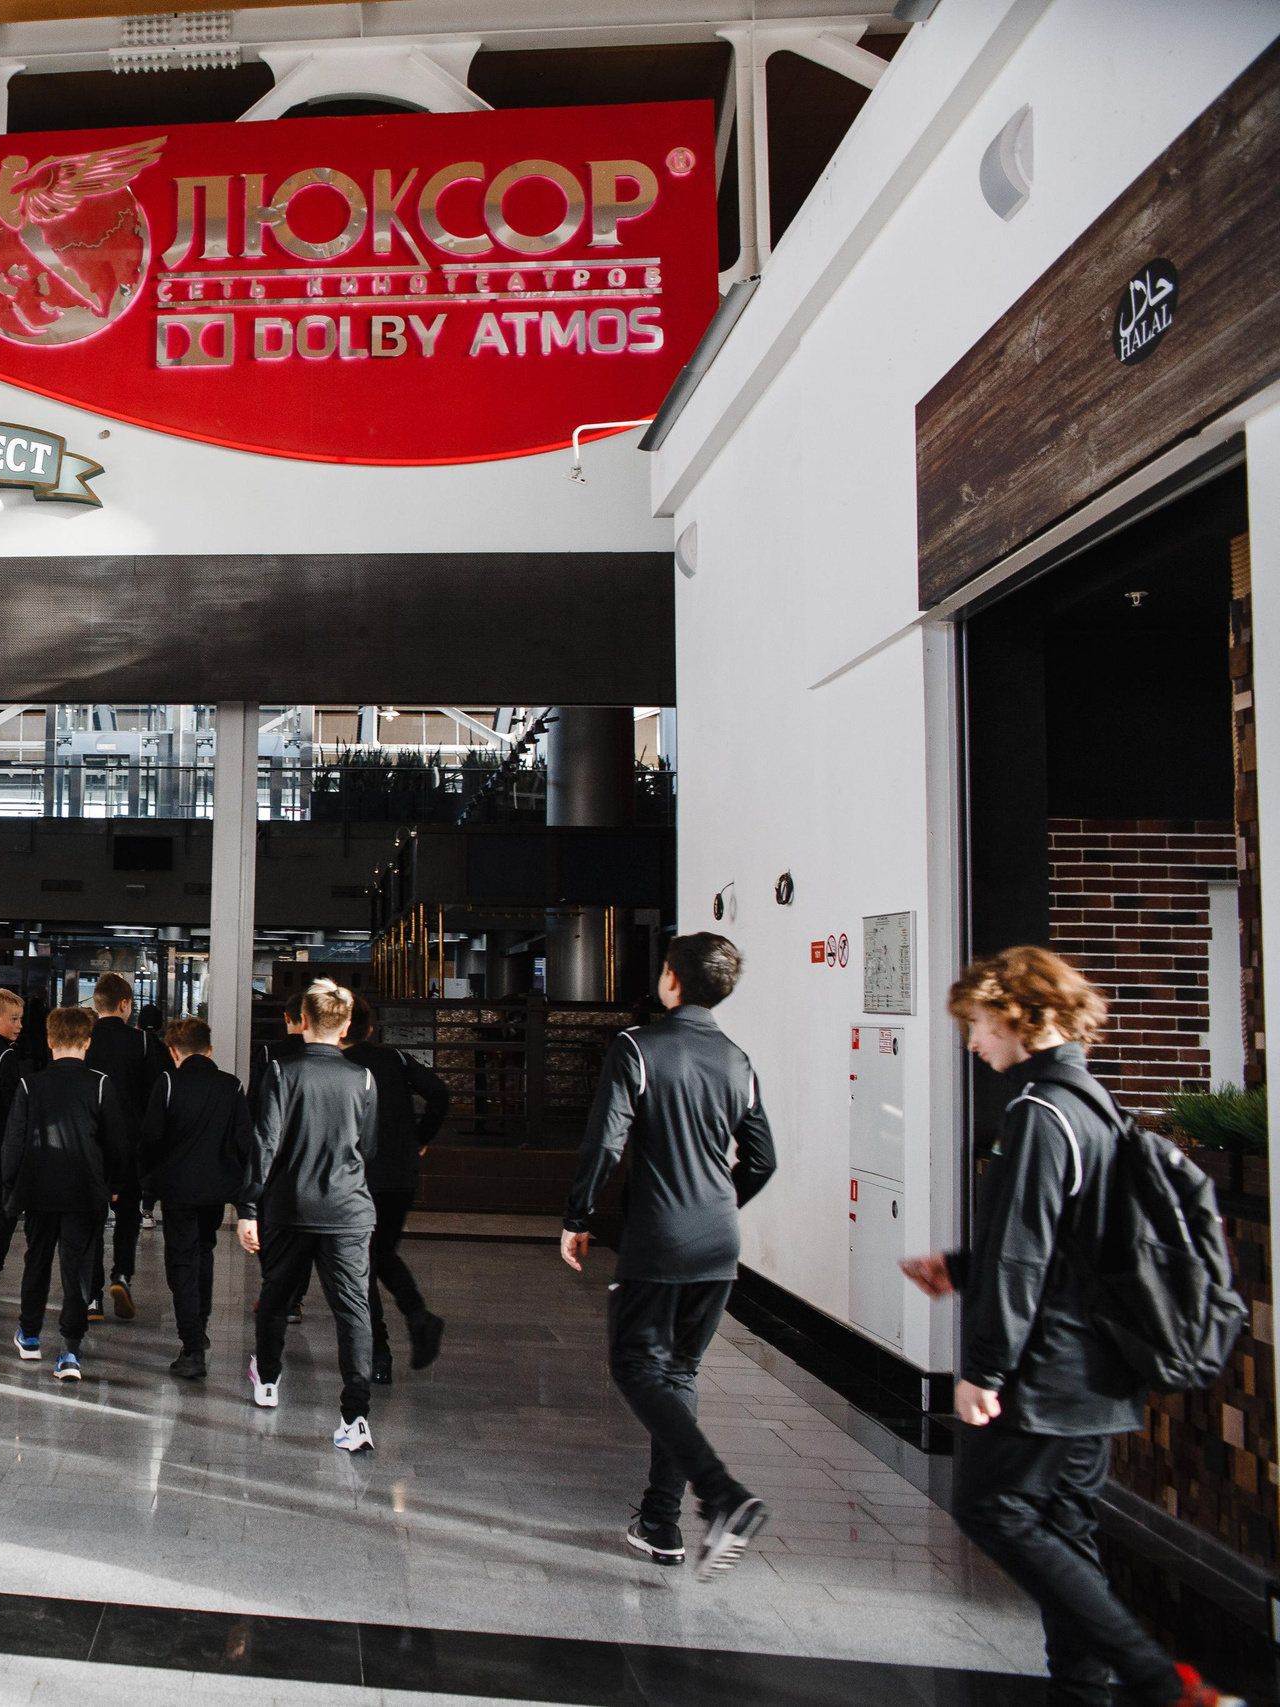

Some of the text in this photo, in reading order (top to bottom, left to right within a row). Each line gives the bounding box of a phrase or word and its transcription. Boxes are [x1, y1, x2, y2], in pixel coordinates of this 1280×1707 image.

[160, 158, 660, 270] ЛЮКСОР
[157, 267, 662, 300] СЕТЬ КИНОТЕАТРОВ
[254, 306, 665, 360] DOLBY ATMOS
[1119, 303, 1173, 362] HALAL
